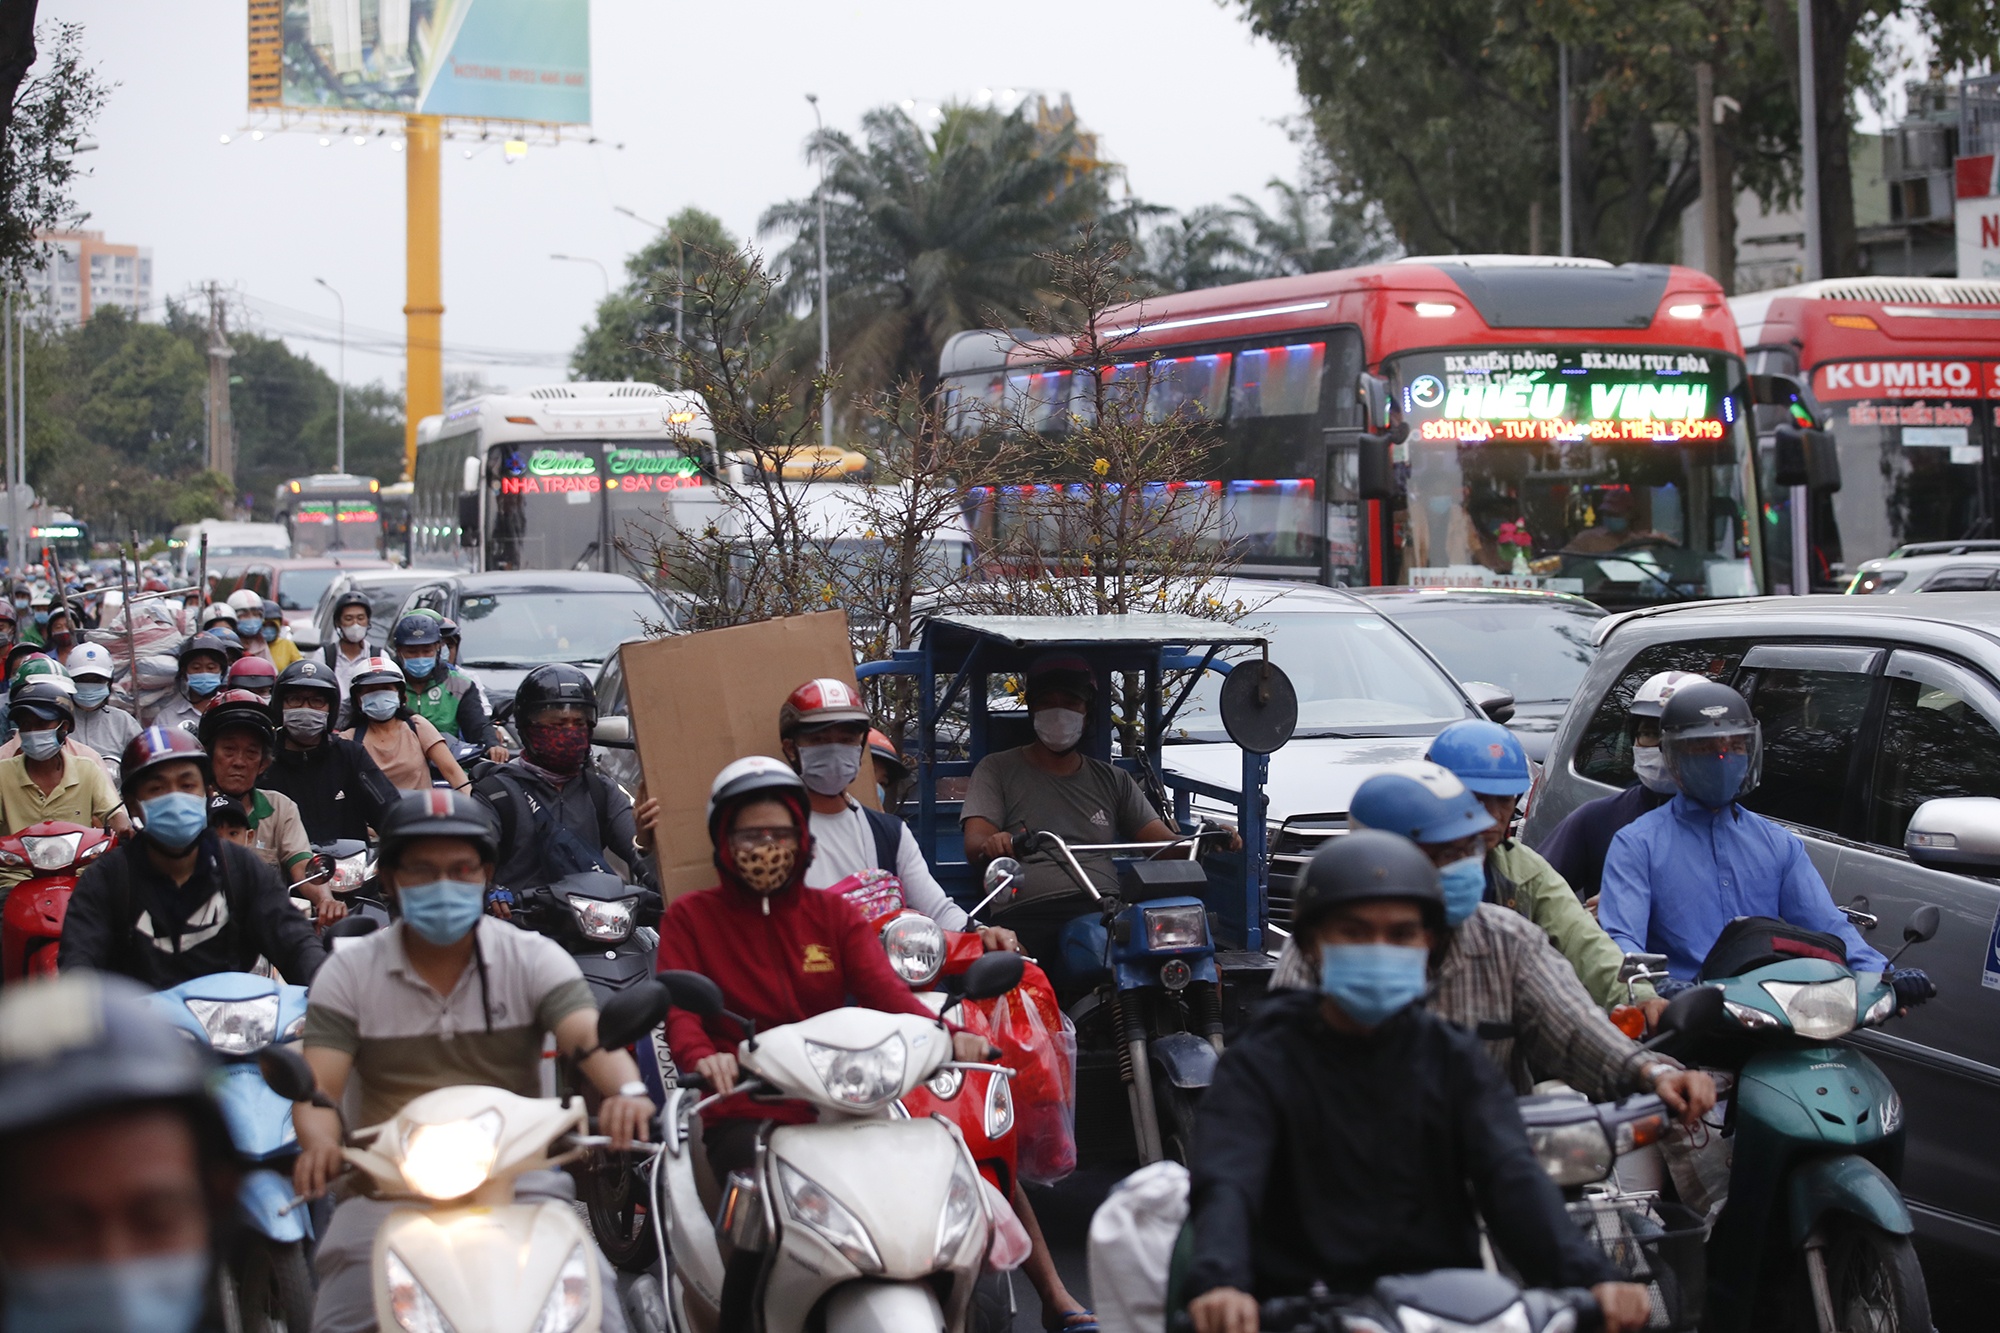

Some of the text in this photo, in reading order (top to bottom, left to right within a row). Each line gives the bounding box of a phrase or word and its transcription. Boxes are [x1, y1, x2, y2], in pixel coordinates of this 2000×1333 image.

[1581, 353, 1641, 370] BX.NAM
[1643, 355, 1674, 371] TUY
[1676, 354, 1710, 373] HÒA
[1826, 362, 1971, 390] KUMHO
[1591, 383, 1708, 419] VINH
[502, 476, 539, 494] NHA
[539, 475, 601, 493] TRANG
[1809, 1062, 1848, 1071] HONDA
